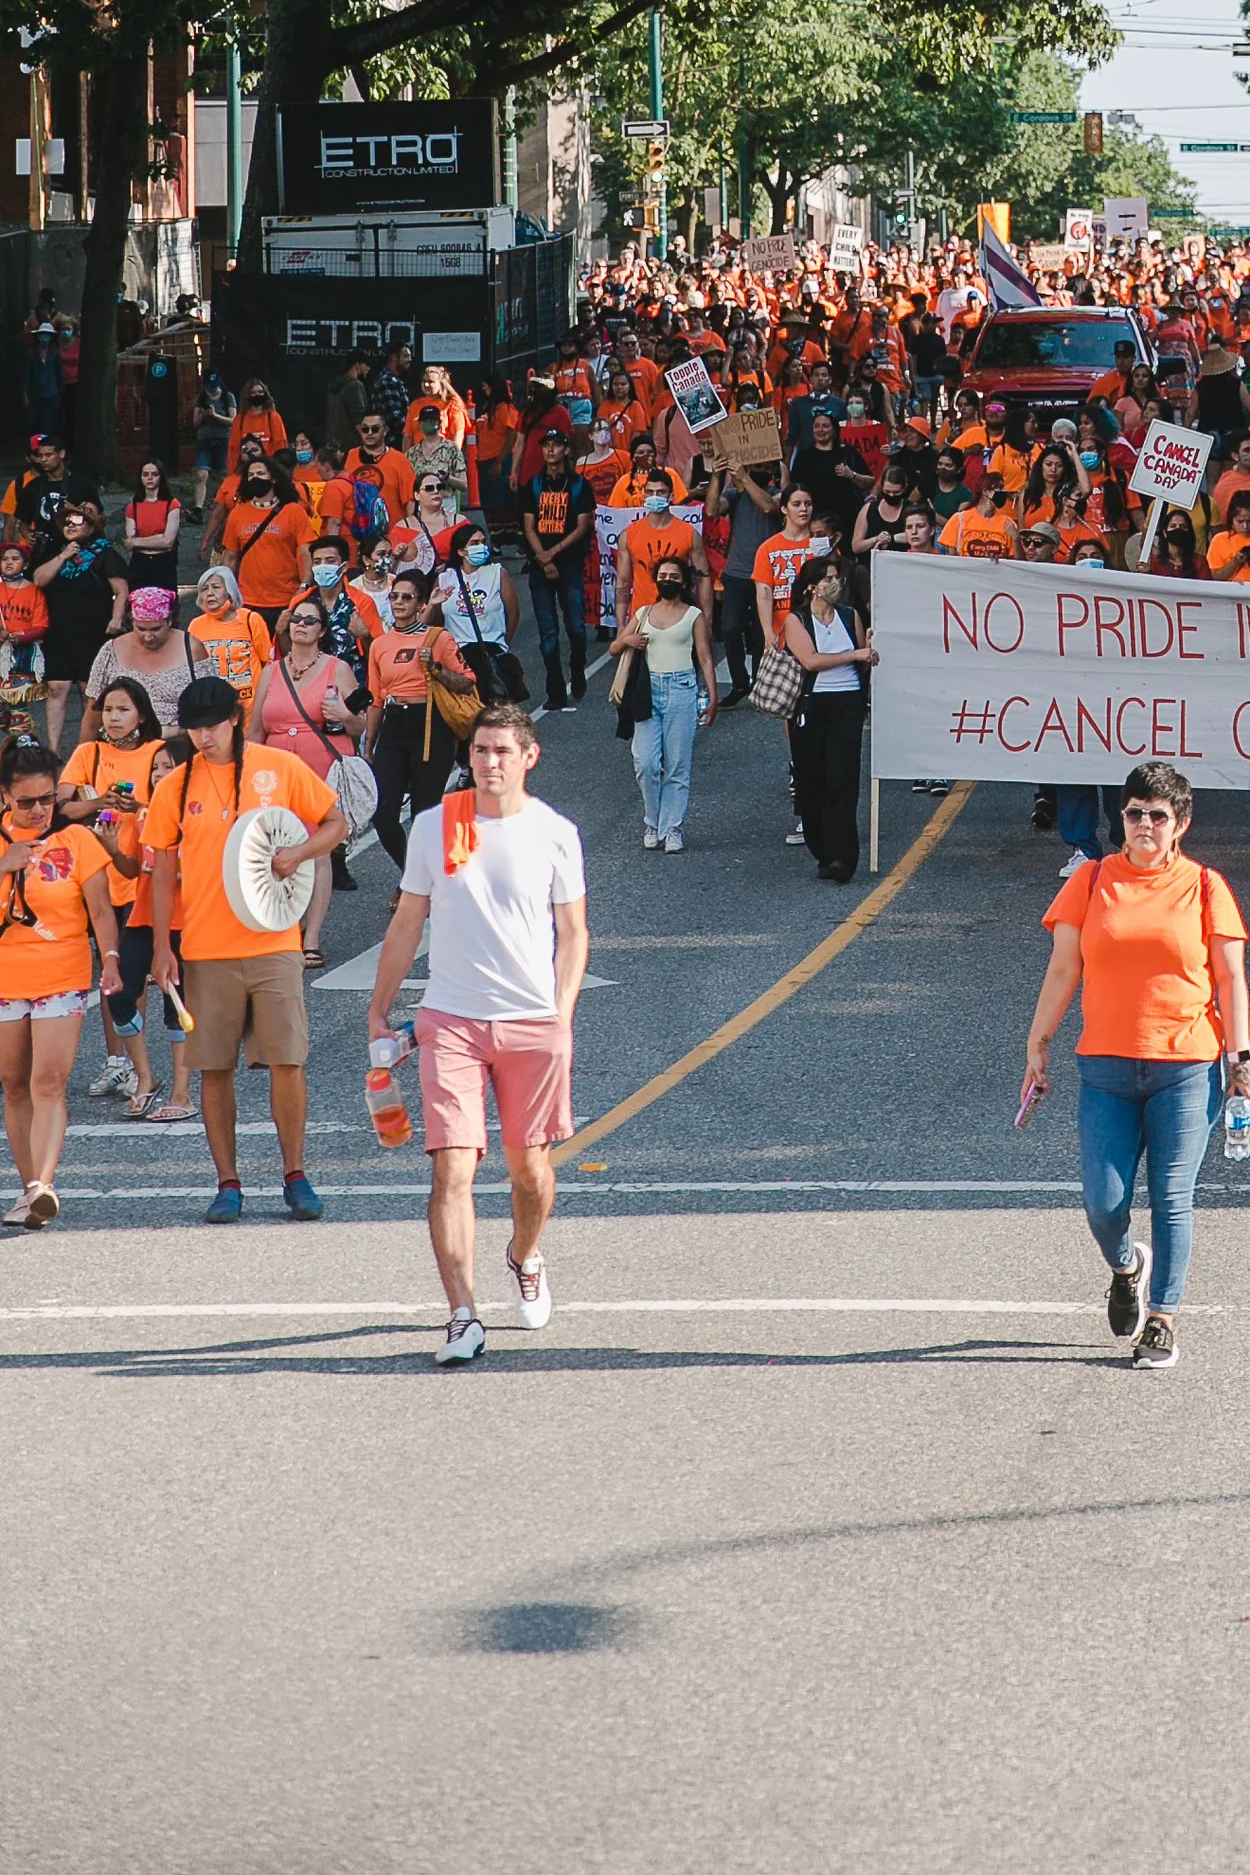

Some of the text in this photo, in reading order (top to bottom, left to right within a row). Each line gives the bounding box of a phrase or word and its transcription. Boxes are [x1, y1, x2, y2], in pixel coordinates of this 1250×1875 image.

[322, 133, 457, 167] ETRO
[324, 165, 455, 178] CONSTRUCTION LIMITED
[837, 228, 858, 240] EVERY
[752, 242, 765, 256] NO
[752, 256, 790, 272] GENOCIDE
[287, 320, 415, 347] ETRO
[667, 362, 700, 383] Topple
[671, 370, 707, 394] Canada
[740, 409, 776, 432] PRIDE
[738, 433, 750, 445] IN
[1153, 435, 1200, 469] CANCEL
[1153, 473, 1180, 490] DAY
[539, 492, 569, 504] EVERY
[538, 504, 567, 522] CHILD
[942, 592, 1024, 653] NO
[1056, 593, 1205, 659] PRIDE
[949, 696, 1203, 758] #CANCEL
